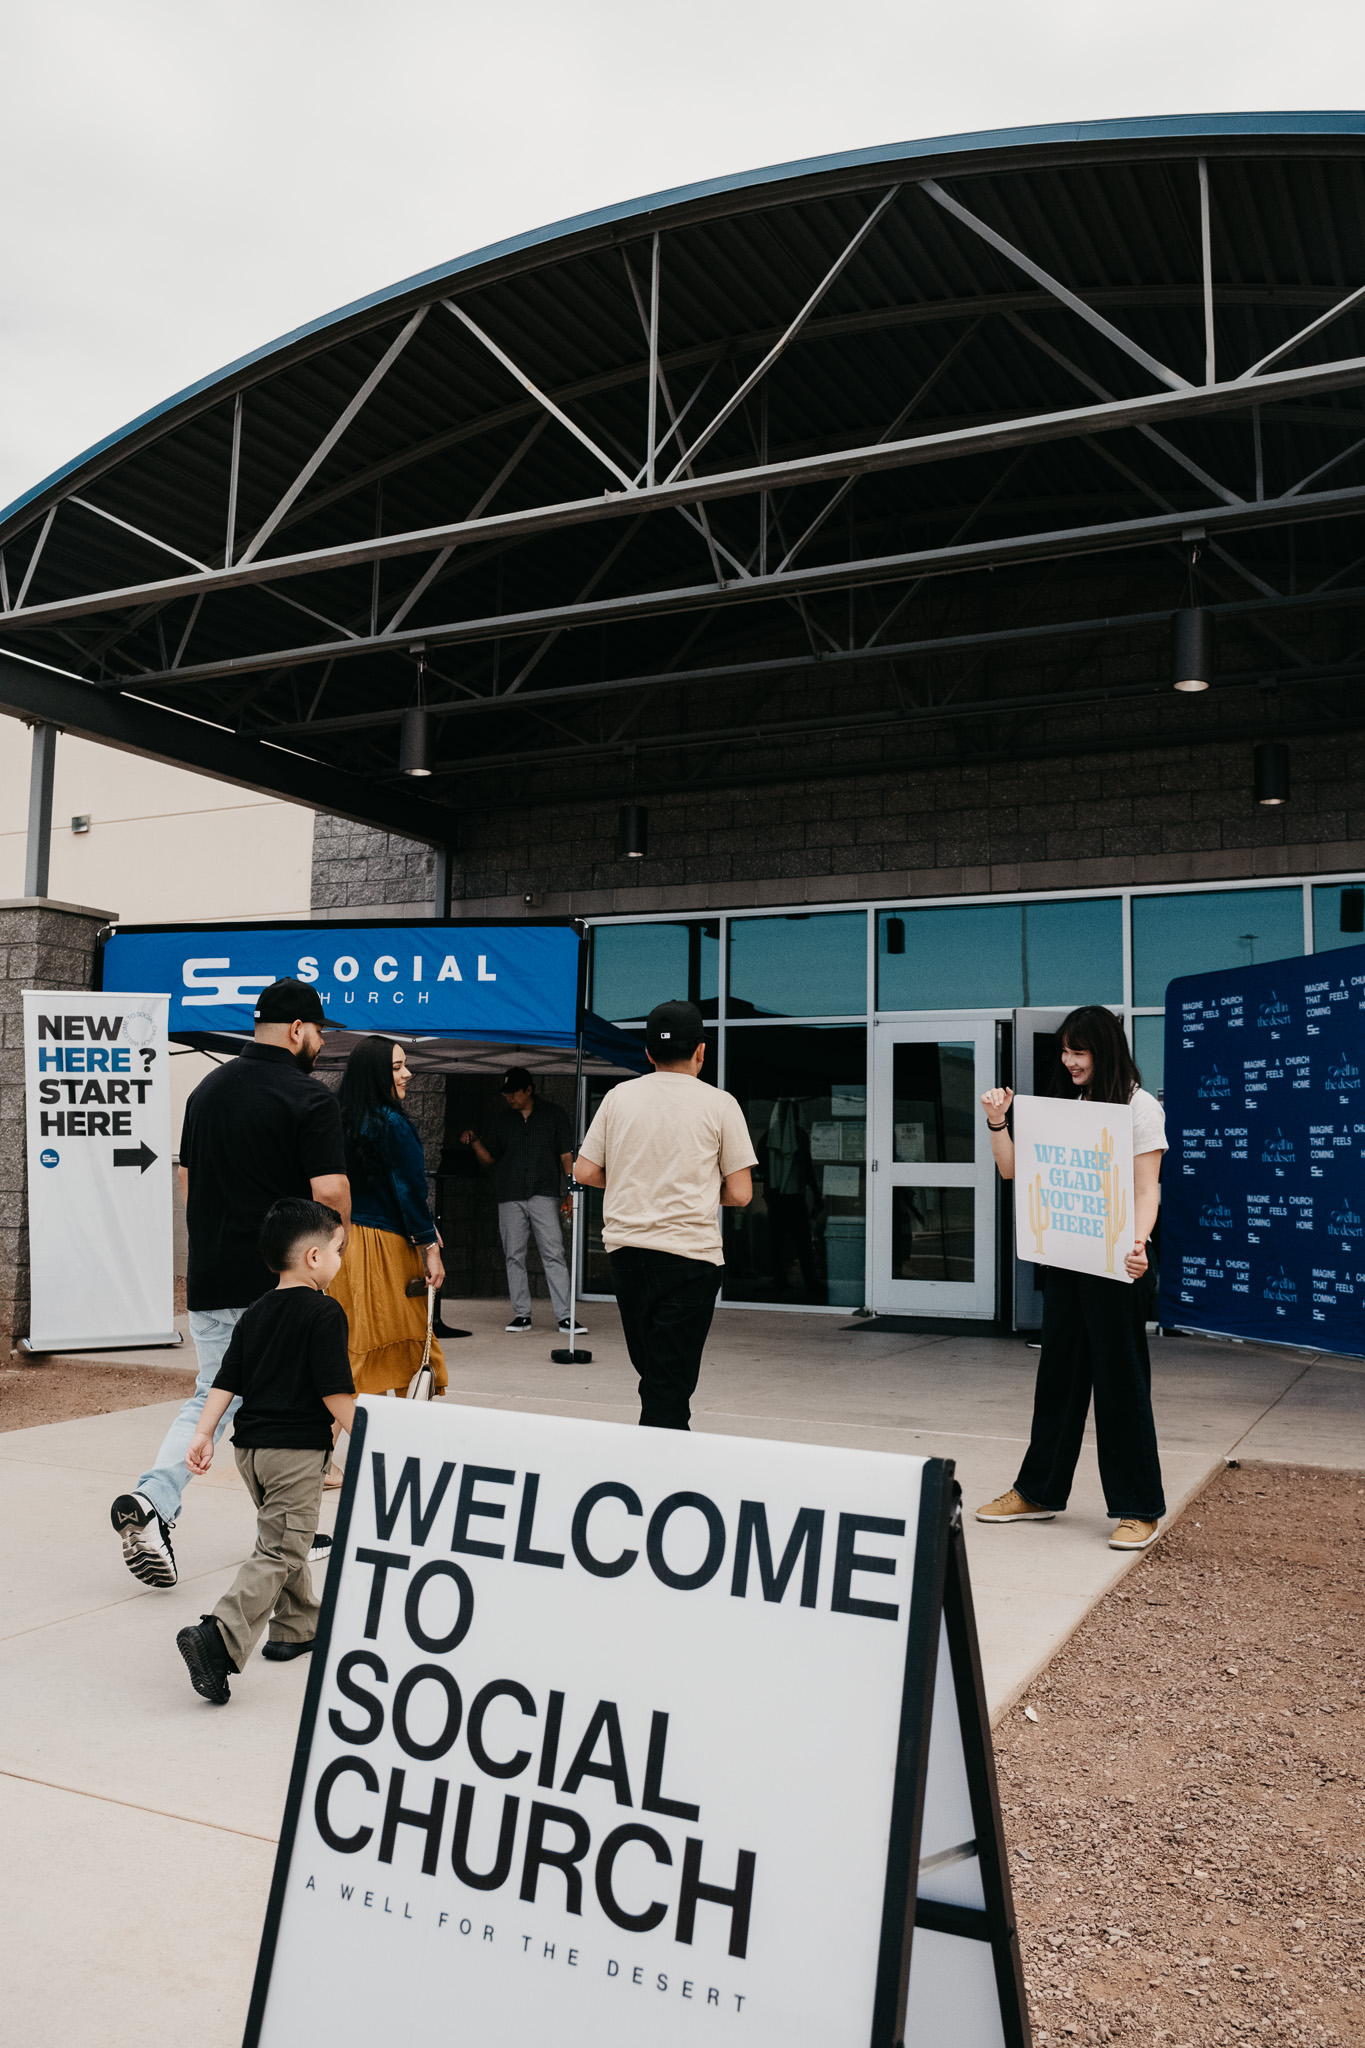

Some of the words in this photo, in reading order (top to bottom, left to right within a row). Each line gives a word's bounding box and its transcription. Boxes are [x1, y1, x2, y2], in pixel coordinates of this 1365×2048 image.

[297, 955, 497, 983] SOCIAL
[1305, 982, 1329, 993] IMAGINE
[318, 991, 430, 1005] HURCH
[1182, 1001, 1203, 1010] IMAGINE
[1221, 996, 1242, 1006] CHURCH
[1306, 995, 1320, 1004] THAT
[1329, 991, 1349, 1001] FEELS
[1183, 1012, 1196, 1020] THAT
[1203, 1010, 1219, 1018] FEELS
[1231, 1006, 1243, 1015] LIKE
[1306, 1006, 1331, 1017] COMING
[38, 1014, 123, 1041] NEW
[1183, 1023, 1204, 1032] COMING
[1228, 1018, 1244, 1027] HOME
[38, 1047, 131, 1073] HERE
[1244, 1060, 1266, 1068] IMAGINE
[1286, 1056, 1310, 1065] CHURCH
[1244, 1072, 1258, 1080] THAT
[1266, 1070, 1283, 1078] FEELS
[1297, 1067, 1310, 1076] LIKE
[39, 1079, 153, 1105] START
[1245, 1083, 1267, 1092] COMING
[1293, 1080, 1310, 1088] HOME
[40, 1111, 132, 1137] HERE
[1310, 1125, 1333, 1134] IMAGINE
[1224, 1128, 1248, 1136] CHURCH
[1235, 1139, 1248, 1147] LIKE
[1310, 1138, 1325, 1146] THAT
[1333, 1137, 1352, 1145] FEELS
[1034, 1143, 1066, 1165] WE
[1070, 1148, 1111, 1172] ARE
[1311, 1150, 1334, 1158] COMING
[1049, 1167, 1102, 1193] GLAD
[1039, 1187, 1109, 1217] YOU'RE
[1247, 1195, 1270, 1203] IMAGINE
[1279, 1196, 1284, 1204] A
[1289, 1196, 1313, 1205] CHURCH
[1248, 1206, 1262, 1214] THAT
[1270, 1207, 1287, 1216] FEELS
[1300, 1209, 1312, 1217] LIKE
[1051, 1212, 1104, 1239] HERE
[1248, 1218, 1270, 1227] COMING
[1296, 1221, 1313, 1230] HOME
[1182, 1256, 1206, 1265] IMAGINE
[1226, 1260, 1250, 1269] CHURCH
[1183, 1266, 1198, 1274] THAT
[1206, 1269, 1224, 1278] FEELS
[1237, 1272, 1249, 1280] LIKE
[1312, 1269, 1336, 1279] IMAGINE
[1346, 1272, 1350, 1280] A
[1182, 1278, 1206, 1288] COMING
[1232, 1284, 1249, 1292] HOME
[1313, 1280, 1328, 1290] THAT
[1336, 1283, 1354, 1293] FEELS
[1313, 1293, 1336, 1304] COMING
[371, 1452, 906, 1621] WELCOME
[355, 1547, 475, 1654] TO
[328, 1649, 700, 1822] SOCIAL
[314, 1755, 757, 1960] CHURCH
[305, 1875, 317, 1892] A
[339, 1883, 414, 1920] WELL
[439, 1912, 495, 1943] FOR
[522, 1935, 581, 1967] THE
[606, 1958, 748, 2014] DESERT
